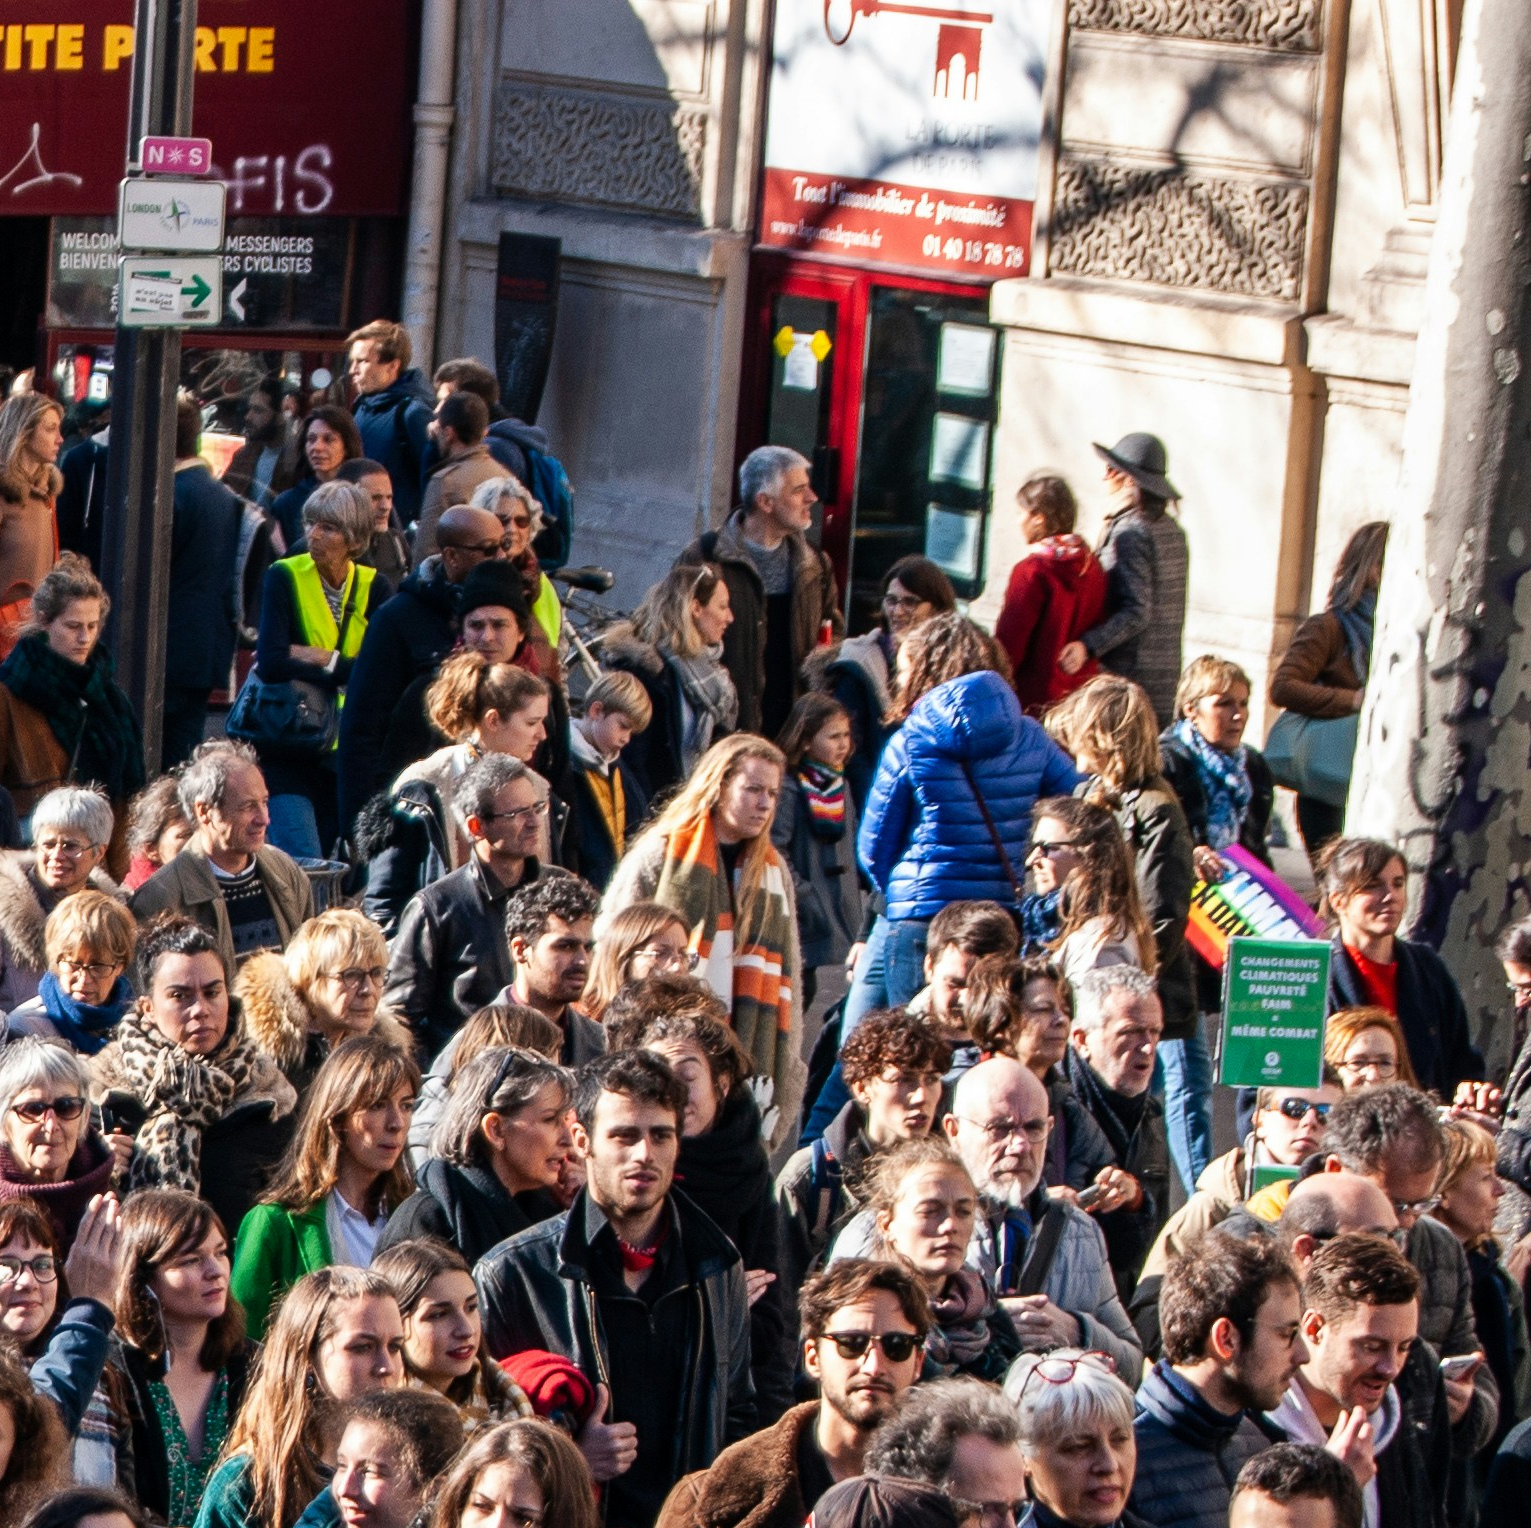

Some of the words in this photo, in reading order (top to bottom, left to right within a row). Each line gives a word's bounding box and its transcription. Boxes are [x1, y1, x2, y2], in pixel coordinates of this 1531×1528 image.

[102, 24, 275, 73] PRTE
[126, 203, 161, 214] LONDON
[62, 232, 120, 250] WELCOM
[226, 235, 314, 254] MESSENGERS
[243, 257, 312, 274] CYCLISTES
[1239, 955, 1320, 969] CHANGEMENTS
[1239, 969, 1318, 984] CLIMATIQUES
[1248, 983, 1307, 997] PAUVRETÉ
[1268, 1027, 1318, 1040] COMBAT
